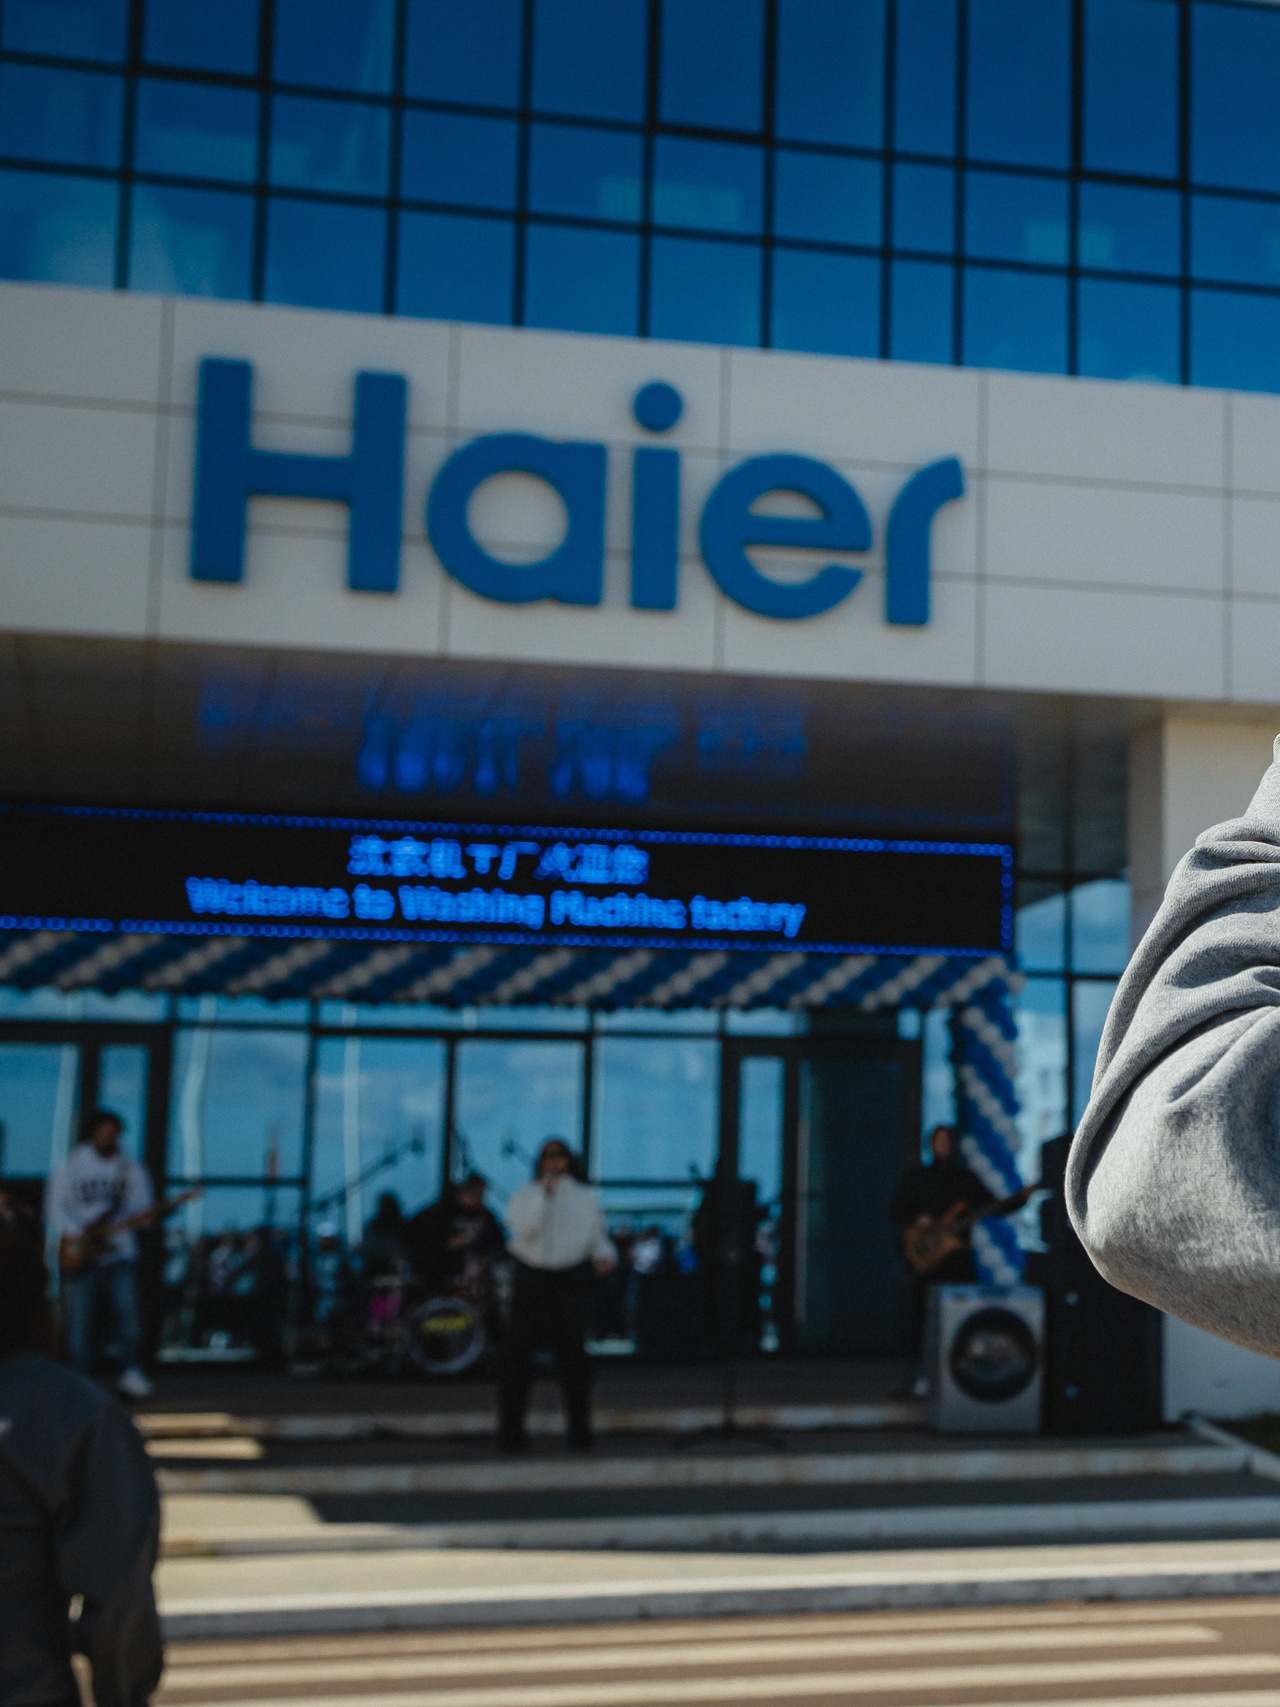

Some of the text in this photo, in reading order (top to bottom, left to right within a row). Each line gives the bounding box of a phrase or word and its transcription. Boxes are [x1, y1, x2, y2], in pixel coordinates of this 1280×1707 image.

[190, 358, 965, 626] Haier
[185, 877, 350, 918] Welcome
[352, 883, 395, 920] to
[398, 885, 545, 930] Washing
[550, 890, 686, 928] Machine
